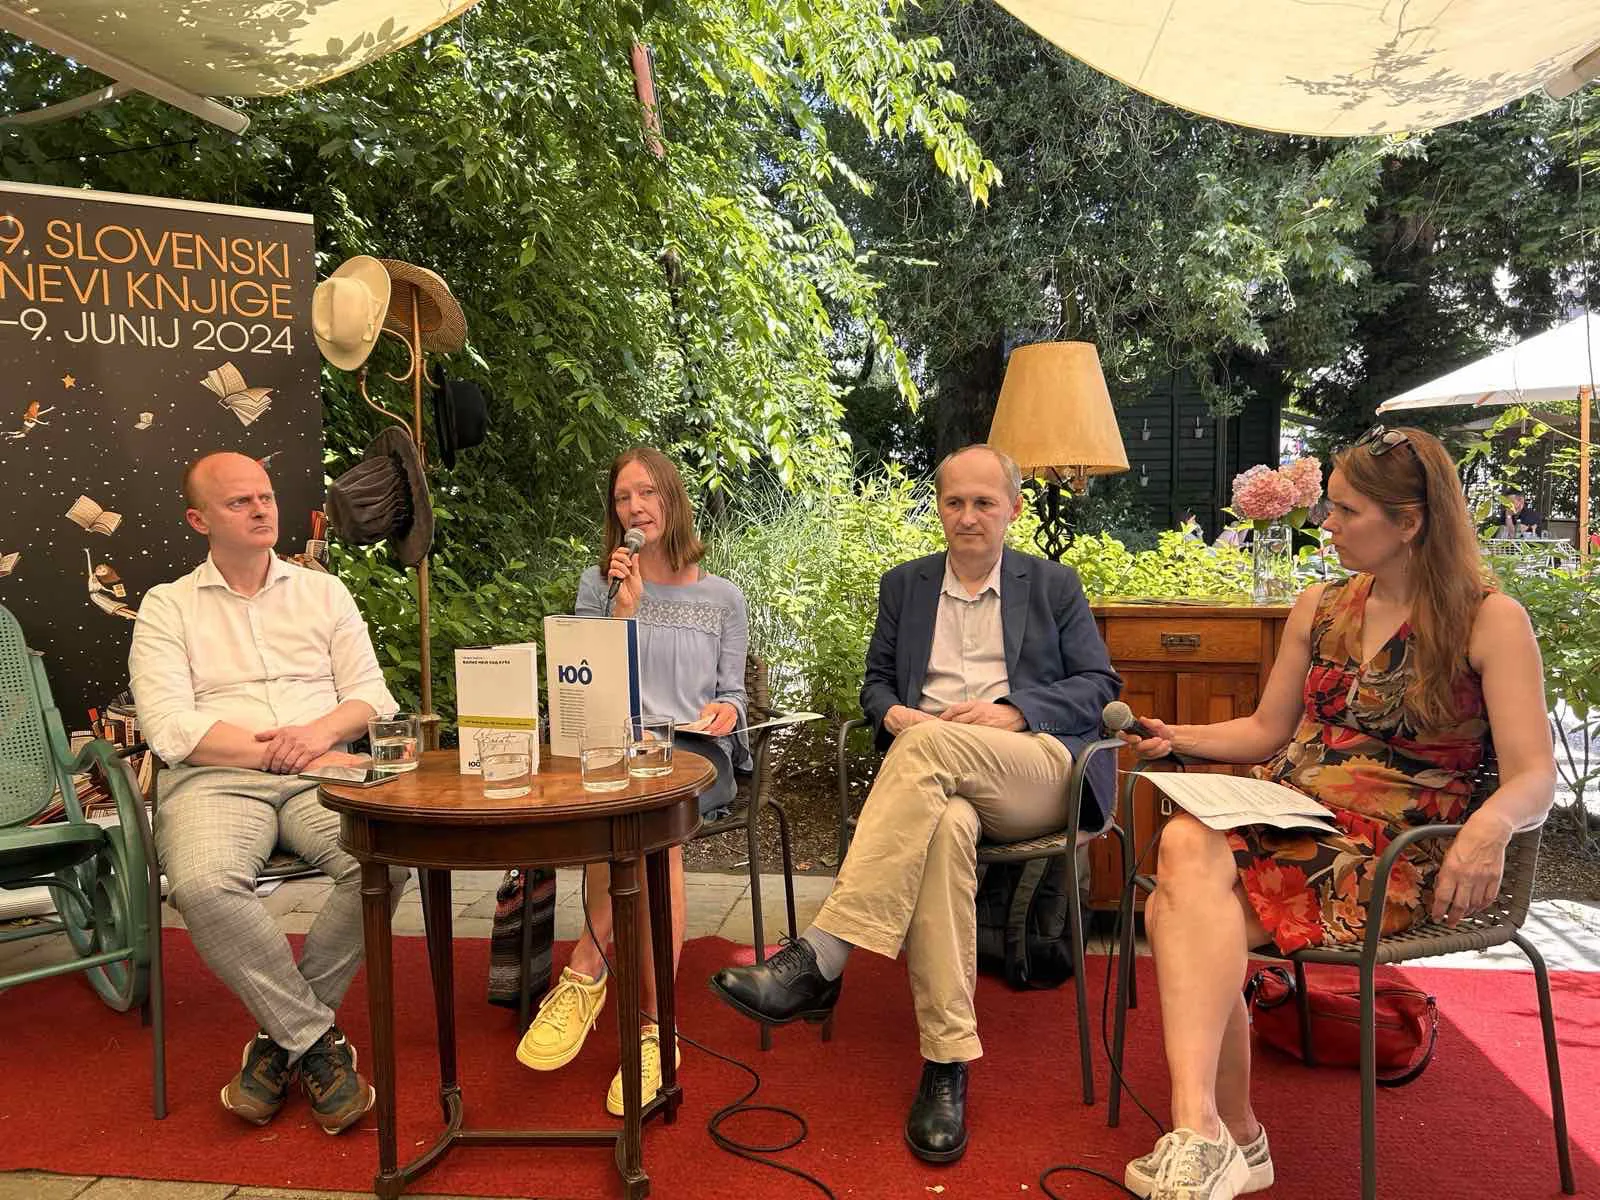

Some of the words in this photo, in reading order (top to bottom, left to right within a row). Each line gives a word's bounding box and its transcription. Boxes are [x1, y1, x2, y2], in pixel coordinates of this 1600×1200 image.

[0, 215, 30, 255] 9.
[45, 219, 290, 279] SLOVENSKI
[0, 261, 110, 306] NEVI
[127, 271, 294, 320] KNJIGE
[64, 311, 180, 350] JUNIJ
[192, 320, 295, 355] 2024
